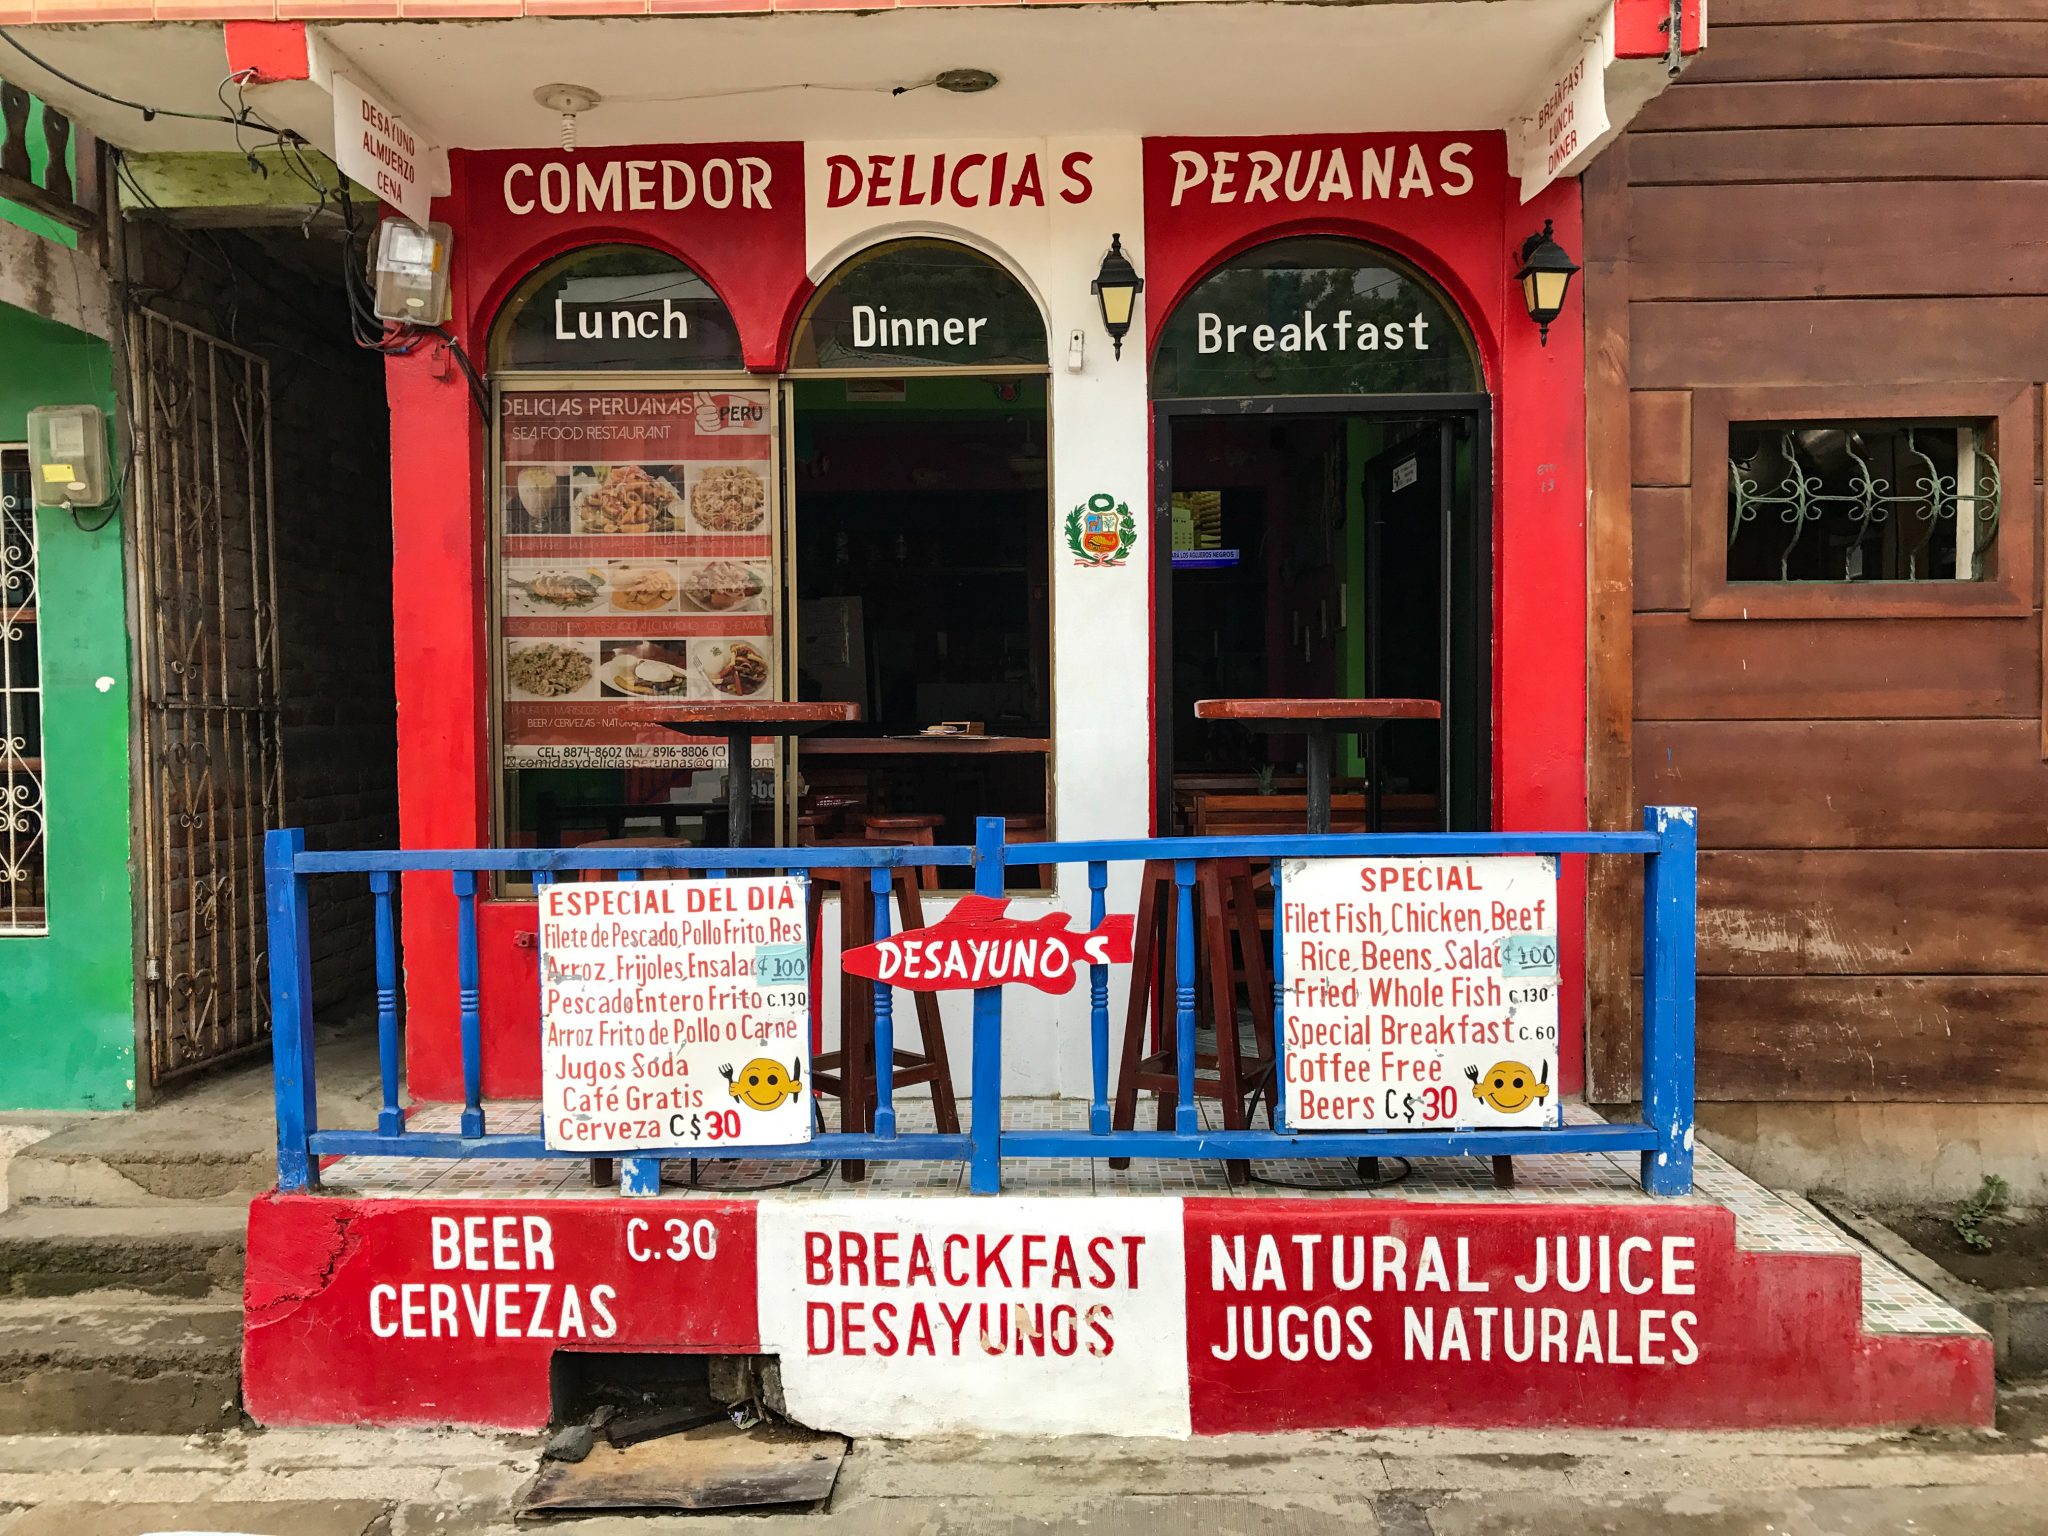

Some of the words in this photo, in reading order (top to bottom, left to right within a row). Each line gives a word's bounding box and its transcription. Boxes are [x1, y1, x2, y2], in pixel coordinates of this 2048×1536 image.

[1538, 58, 1585, 130] BREAKFAST
[361, 99, 415, 157] DESAYUNO
[1549, 101, 1574, 146] LUNCH
[363, 131, 415, 184] ALMUERZO
[1548, 129, 1578, 176] DINNER
[377, 171, 402, 204] CENA
[503, 157, 773, 215] COMEDOR
[826, 151, 1094, 208] DELICIAS
[1170, 142, 1475, 207] PERUANAS
[555, 298, 688, 340] Lunch
[852, 305, 988, 348] Dinner
[1197, 310, 1430, 354] Breakfast
[502, 397, 583, 417] DELICIAS
[590, 396, 693, 416] PERUANAS
[719, 405, 763, 421] PERU
[512, 426, 539, 440] SEA
[541, 425, 583, 440] FOOD
[586, 425, 671, 440] RESTAURANT
[1212, 550, 1235, 558] NEGROS
[527, 718, 547, 728] BEER
[554, 718, 596, 728] CERVEZAS
[563, 746, 622, 760] 8874-8602
[652, 746, 709, 758] 8916-8806
[712, 745, 726, 758] (C)
[1360, 865, 1483, 892] SPECIAL
[549, 888, 675, 917] ESPECIAL
[687, 886, 738, 914] DEL
[748, 884, 794, 910] DIA
[1284, 902, 1330, 934] Filet
[1336, 903, 1388, 936] Fish,
[1391, 901, 1490, 935] Chicken,
[1492, 899, 1546, 932] Beef
[544, 923, 587, 949] Filete
[591, 922, 610, 949] de
[770, 917, 802, 944] Res
[875, 935, 1110, 981] DESAYUNOS
[1301, 941, 1358, 973] Rice,
[1363, 940, 1441, 973] Beens,
[548, 989, 633, 1015] Pescado
[636, 988, 704, 1012] Entero
[709, 985, 762, 1010] Frito
[766, 992, 806, 1008] C.130
[1295, 977, 1357, 1008] Fried
[1369, 977, 1443, 1007] Whole
[1452, 976, 1501, 1007] Fish
[548, 1022, 593, 1047] Arroz
[600, 1020, 645, 1046] Frito
[649, 1019, 669, 1044] de
[674, 1018, 720, 1044] Pollo
[725, 1023, 737, 1041] o
[741, 1015, 798, 1041] Carne
[1288, 1015, 1371, 1049] Special
[1381, 1014, 1515, 1046] Breakfast
[556, 1054, 626, 1087] Jugos
[632, 1052, 689, 1078] Soda
[1285, 1052, 1371, 1084] Coffee
[1381, 1051, 1442, 1082] Free
[563, 1085, 620, 1112] Café
[626, 1083, 703, 1111] Gratis
[1300, 1089, 1375, 1120] Beers
[559, 1117, 661, 1142] Cerveza
[431, 1216, 555, 1271] BEER
[627, 1217, 719, 1262] C.30
[804, 1231, 1146, 1290] BREACKFAST
[1211, 1233, 1490, 1293] NATURAL
[1514, 1235, 1696, 1295] JUICE
[369, 1283, 617, 1339] CERVEZAS
[805, 1301, 1115, 1358] DESAYUNOS
[1211, 1305, 1373, 1362] JUGOS
[1404, 1306, 1699, 1365] NATURALES
